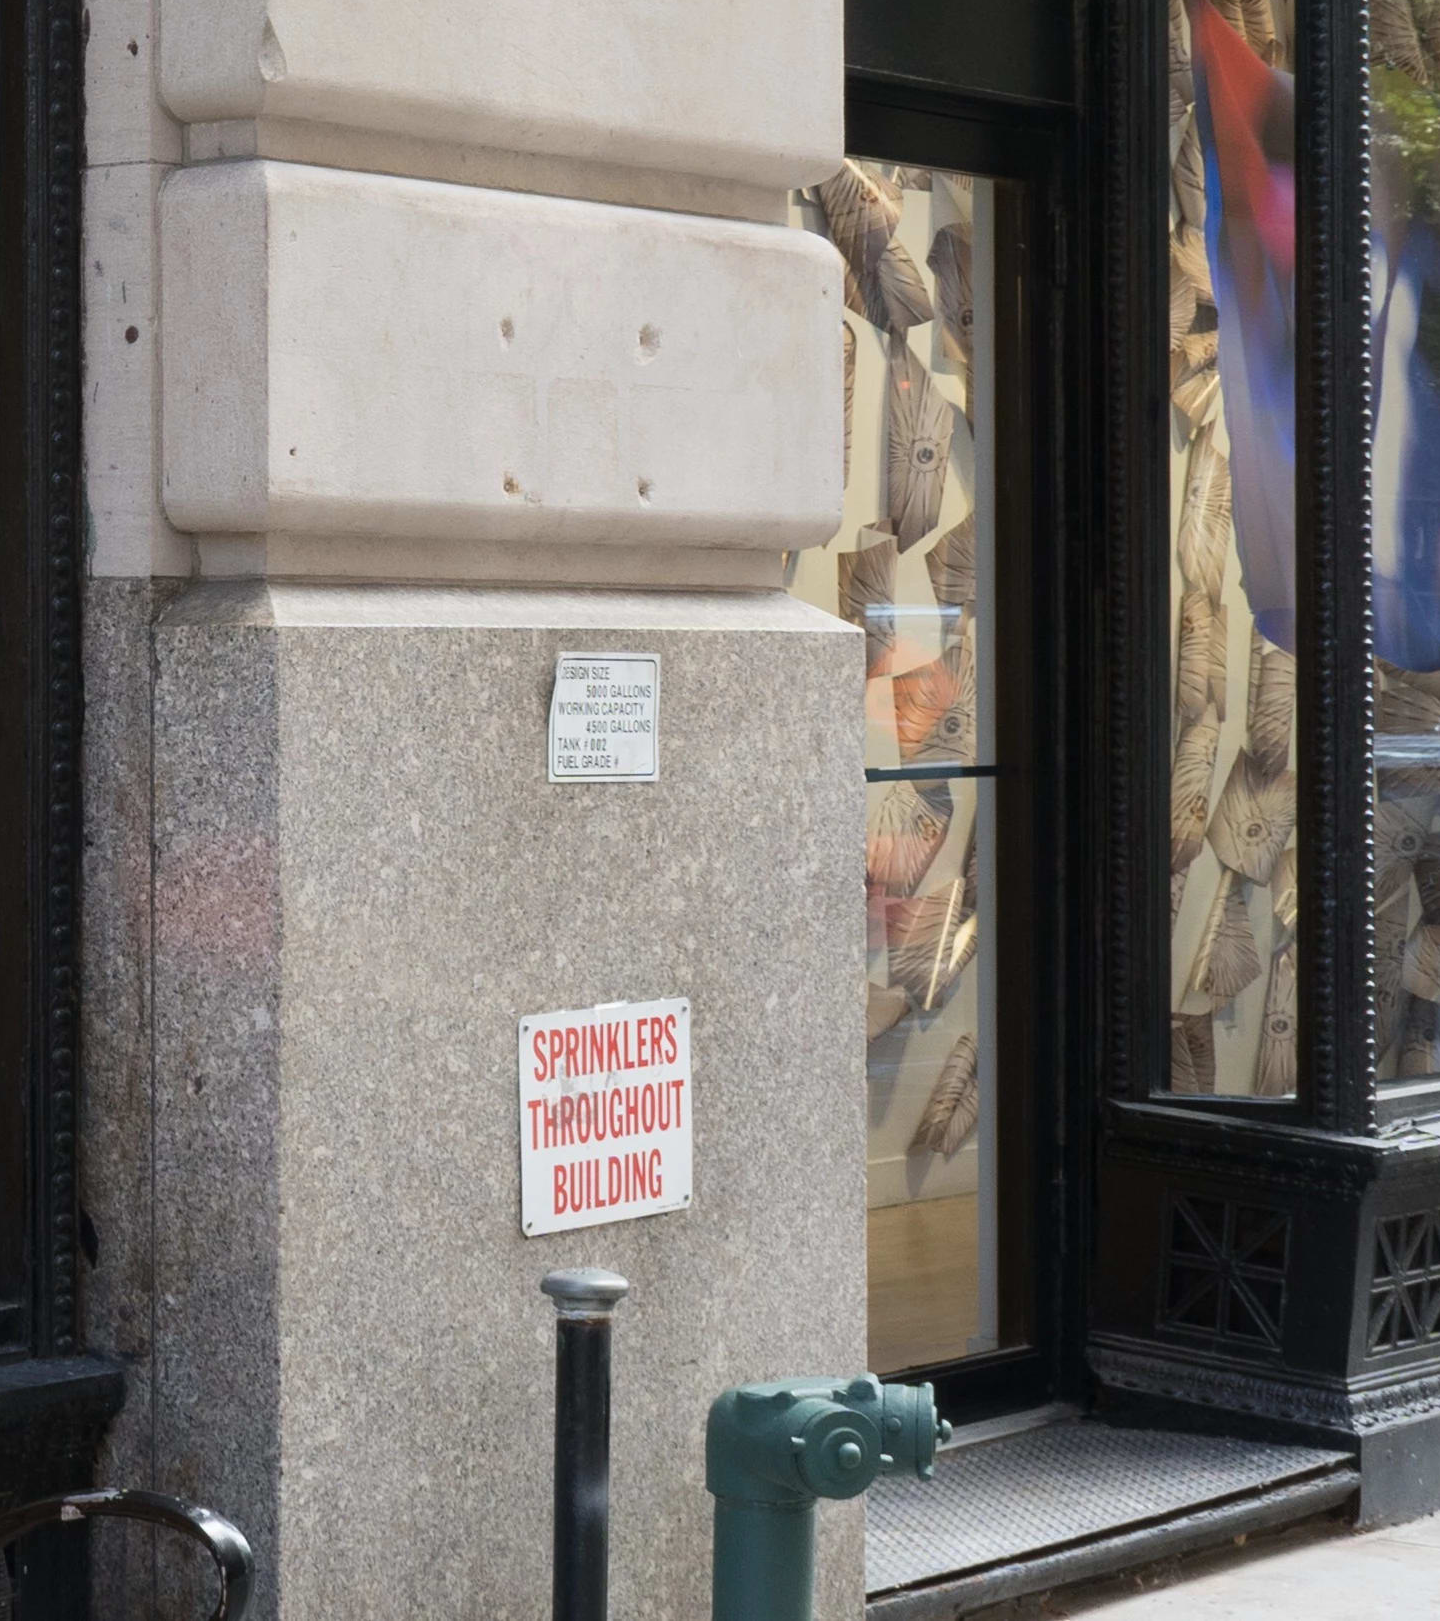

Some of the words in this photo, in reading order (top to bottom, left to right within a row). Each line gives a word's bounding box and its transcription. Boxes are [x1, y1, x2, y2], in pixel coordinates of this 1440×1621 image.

[561, 666, 589, 680] DESIGN
[591, 666, 610, 680] SIZE
[586, 684, 607, 698] 5000
[609, 684, 651, 698] GALLONS
[558, 701, 599, 716] WORKING
[600, 701, 644, 716] CAPACITY
[586, 719, 607, 733] 4500
[609, 719, 651, 733] GALLONS
[558, 737, 581, 751] TANK
[558, 755, 579, 769] FUEL
[581, 755, 612, 769] GRADE
[533, 1013, 678, 1082] SPRINKLERS
[527, 1079, 685, 1151] THROUGHOUT
[553, 1148, 663, 1216] BUILDING
